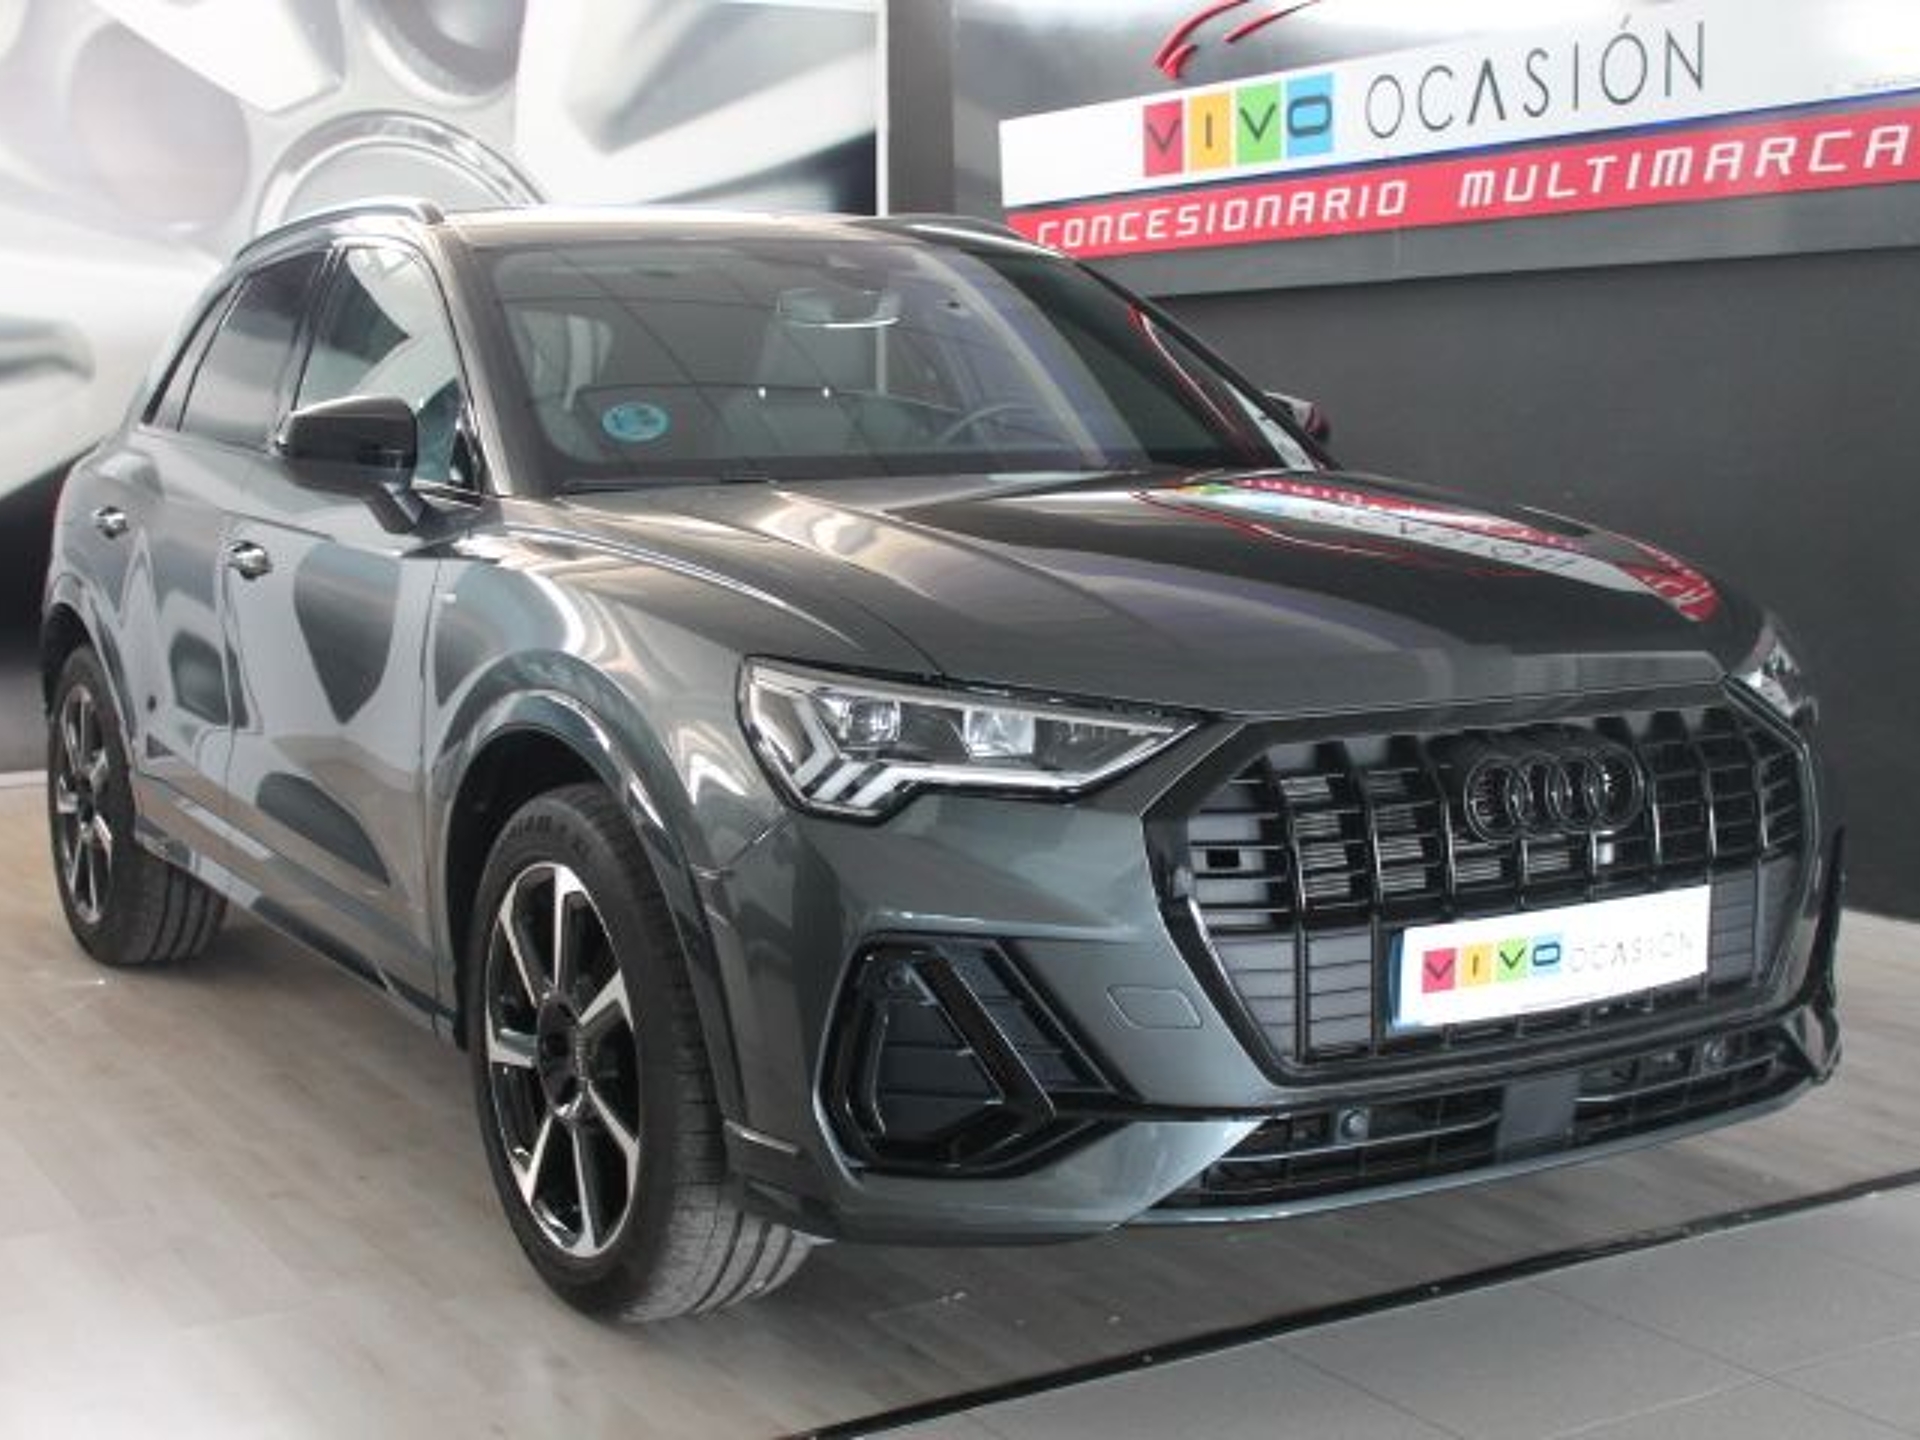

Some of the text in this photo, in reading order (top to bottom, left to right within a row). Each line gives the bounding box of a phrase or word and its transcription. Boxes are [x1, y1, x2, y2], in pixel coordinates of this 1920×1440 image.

[1145, 14, 1705, 156] VIVO OCASIÓN
[1037, 124, 1910, 250] CONCESIONARIO MULTIMARCA
[1424, 942, 1562, 981] VIVO
